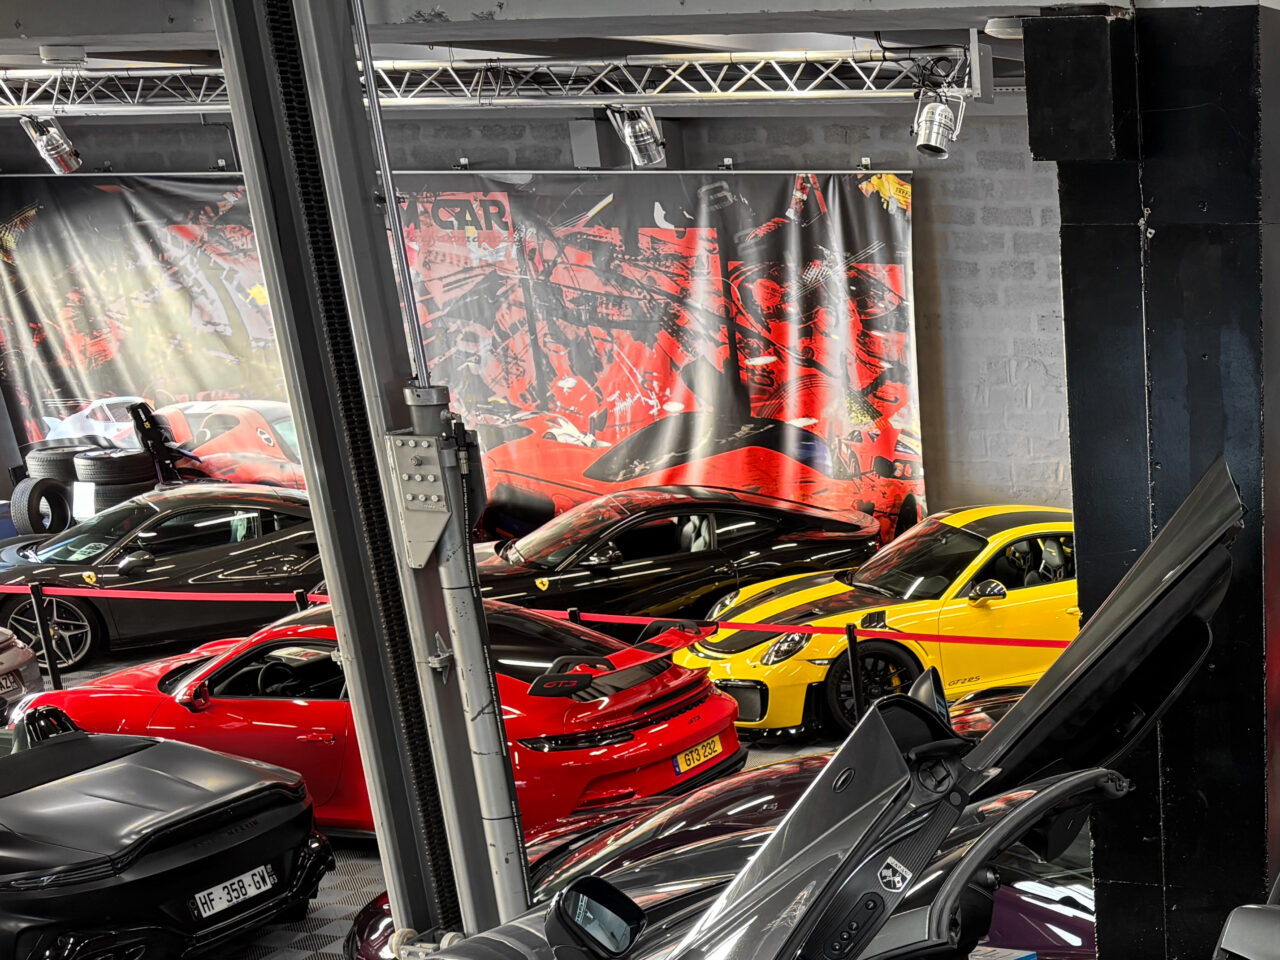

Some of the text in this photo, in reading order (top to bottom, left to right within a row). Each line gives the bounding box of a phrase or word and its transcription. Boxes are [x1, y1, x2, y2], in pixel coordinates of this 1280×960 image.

[431, 199, 510, 231] CAR
[543, 680, 578, 689] GT3
[684, 740, 718, 767] GT3 232
